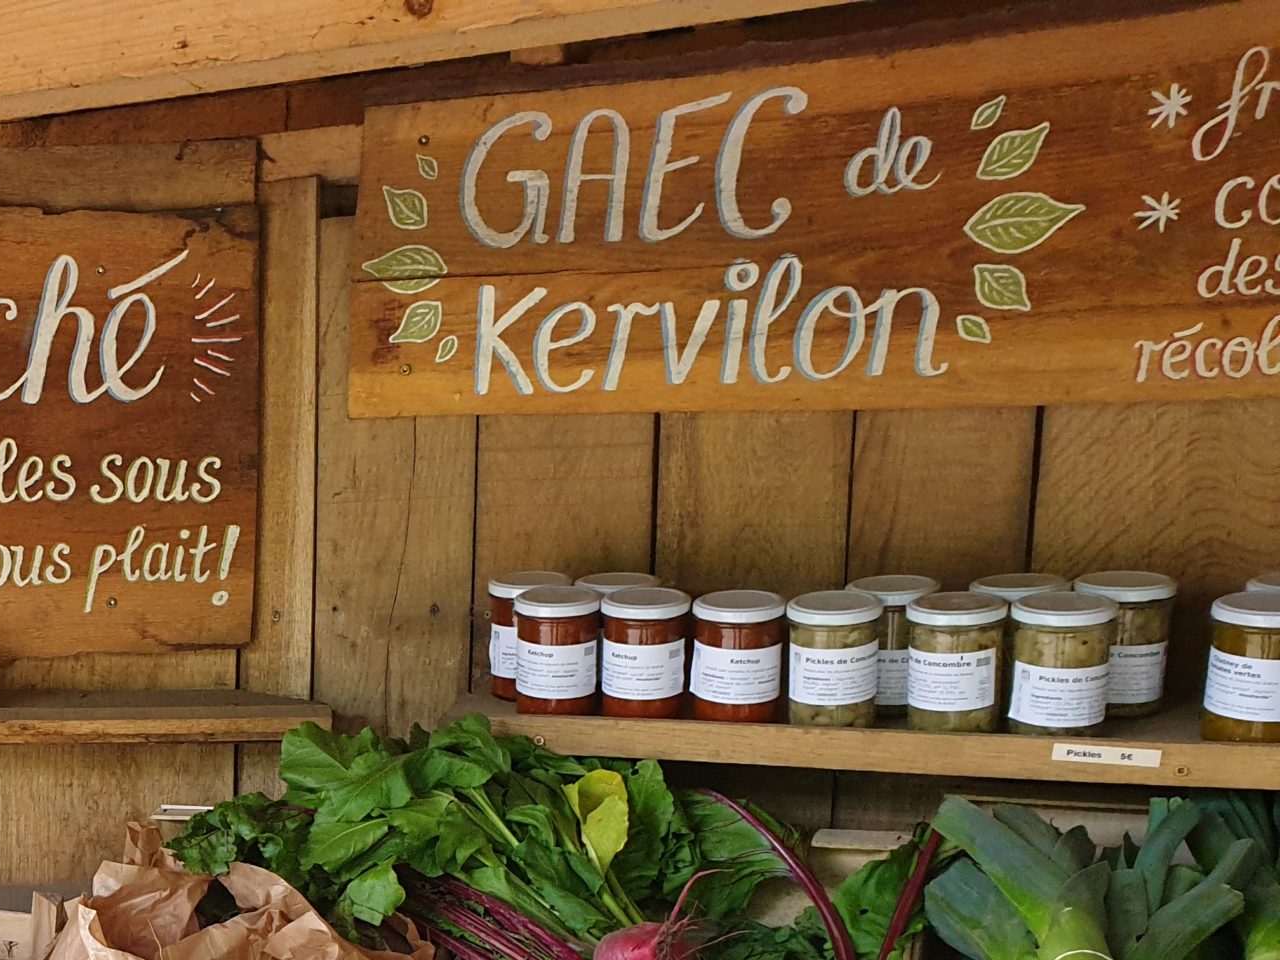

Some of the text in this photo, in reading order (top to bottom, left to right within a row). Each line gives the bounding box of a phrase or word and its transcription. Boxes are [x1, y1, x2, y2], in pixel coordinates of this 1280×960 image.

[460, 86, 942, 249] GAEC de
[474, 253, 950, 397] Kervilon
[89, 454, 223, 503] sous
[805, 657, 834, 665] Pickles
[1038, 675, 1069, 684] Pickles
[1066, 749, 1102, 759] Pickles
